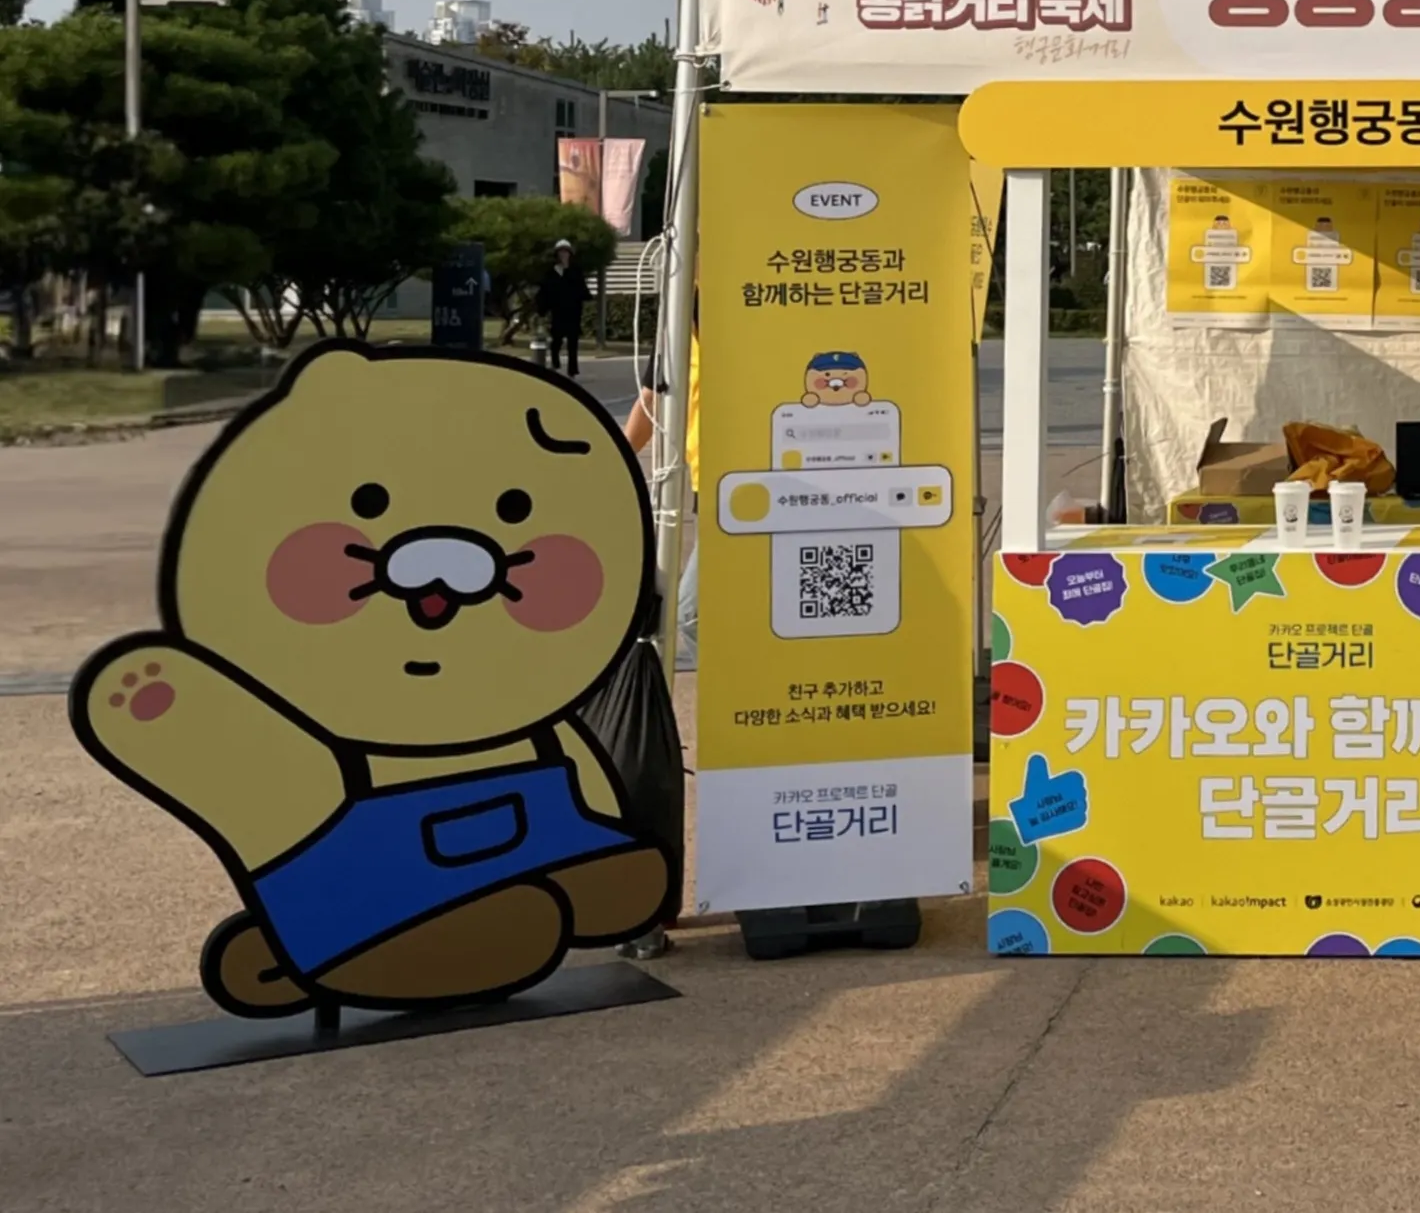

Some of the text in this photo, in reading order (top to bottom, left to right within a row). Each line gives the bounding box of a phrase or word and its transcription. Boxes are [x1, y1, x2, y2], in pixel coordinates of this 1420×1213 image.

[810, 194, 863, 207] EVENT
[767, 248, 906, 274] 수원행궁동과
[742, 280, 930, 307] 함께하는 단골거리
[777, 492, 878, 507] 수원행궁동_official
[1066, 568, 1105, 586] 오늘부터
[1268, 622, 1374, 637] 카카오 프로젝트 단골
[1267, 640, 1374, 670] 단골거리
[787, 680, 884, 700] 친구 추가하고
[734, 701, 936, 727] 다양한 소식과 혜택 받으세요!
[1064, 695, 1315, 761] 카카오와
[773, 783, 898, 805] 카카오 프로젝트 단골
[772, 804, 898, 843] 단골거리
[1159, 896, 1194, 907] kakao
